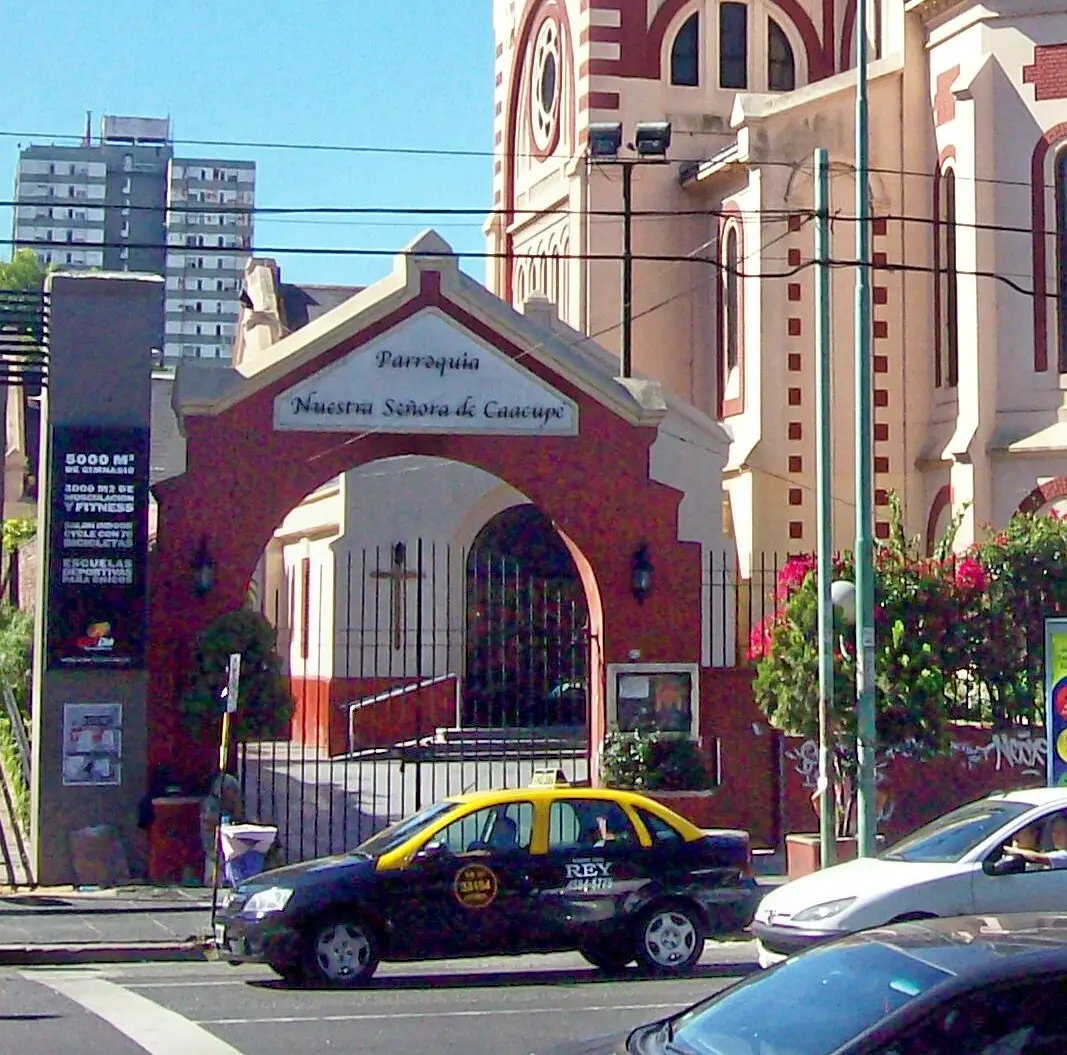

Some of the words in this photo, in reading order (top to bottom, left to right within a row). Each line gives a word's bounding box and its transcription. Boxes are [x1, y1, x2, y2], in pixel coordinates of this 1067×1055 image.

[376, 350, 479, 377] Parroquia
[291, 391, 373, 415] Nuestra
[382, 398, 449, 416] Señora
[456, 396, 476, 417] de
[484, 401, 566, 428] Caacupé
[65, 453, 109, 465] 5000
[75, 502, 135, 513] FITNESS
[62, 558, 133, 568] ESCUELAS
[565, 862, 612, 878] REY
